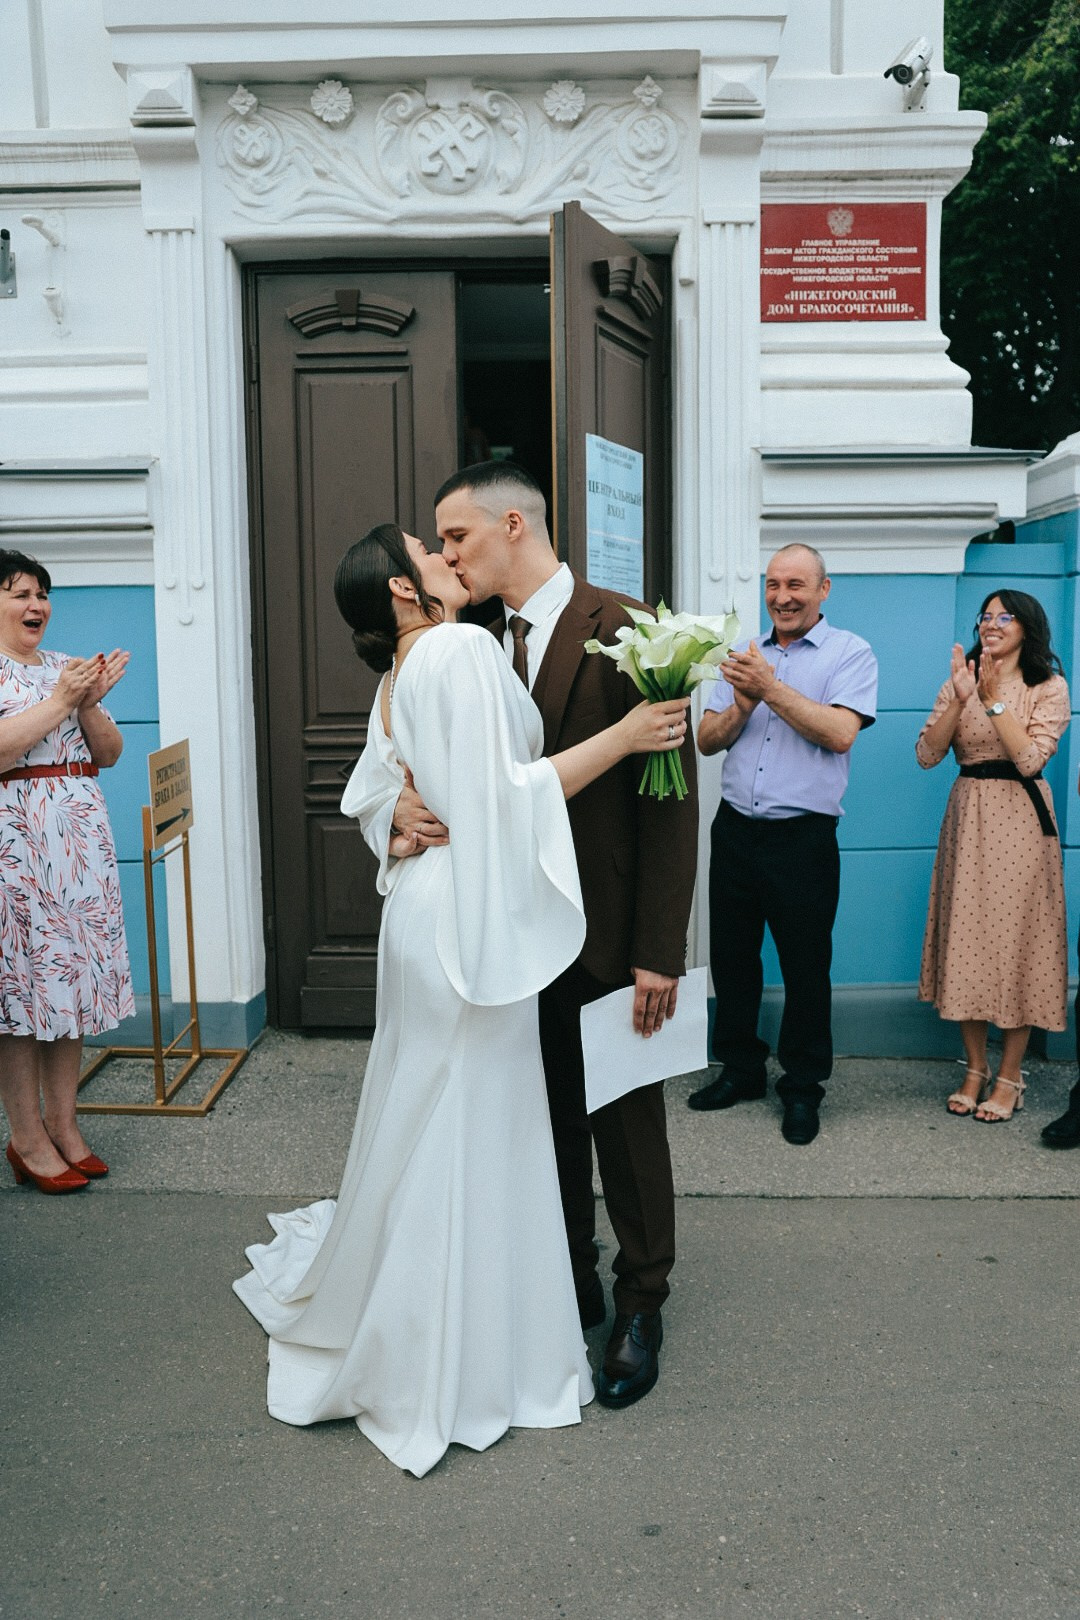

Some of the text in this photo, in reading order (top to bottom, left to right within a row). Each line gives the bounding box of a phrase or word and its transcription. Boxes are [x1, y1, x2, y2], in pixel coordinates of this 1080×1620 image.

[801, 239, 833, 247] ГЛАВНОЕ
[876, 246, 918, 254] СОСТОЯНИЯ
[856, 254, 889, 262] ОБЛАСТИ
[760, 267, 827, 275] ГОСУДАРСТВЕННОЕ
[875, 266, 922, 275] УЧРЕЖДЕНИЕ
[792, 274, 889, 283] НИЖЕГОРОДСКОЙ ОБЛАСТИ
[784, 288, 897, 301] «НИЖЕГОРОДСКИЙ
[766, 303, 915, 316] ДОМ БРАКОСОЧЕТАНИЯ»
[588, 479, 642, 507] ЦЕНТРАЛЬНЫЙ
[607, 503, 625, 519] ВХОД
